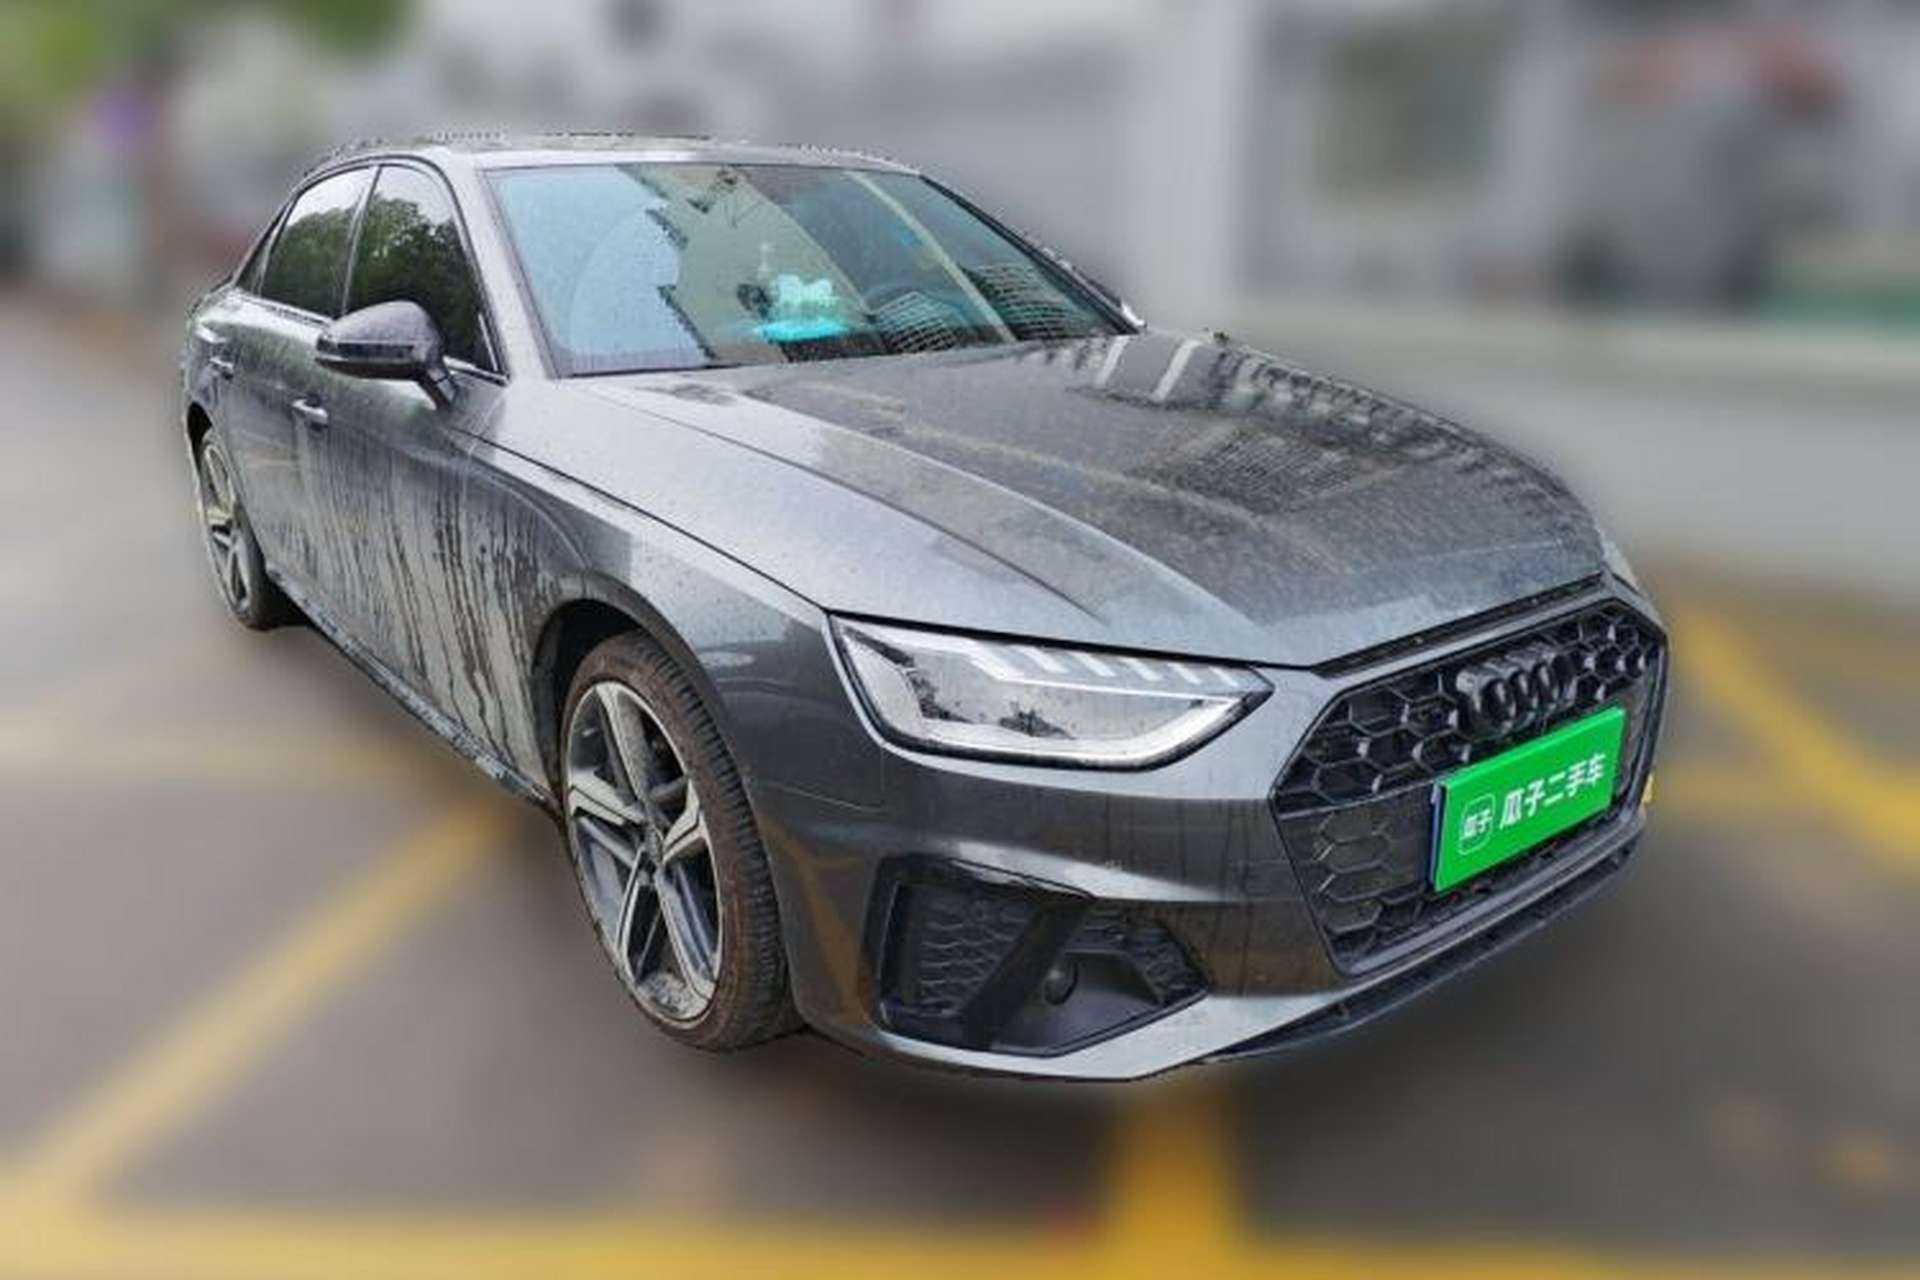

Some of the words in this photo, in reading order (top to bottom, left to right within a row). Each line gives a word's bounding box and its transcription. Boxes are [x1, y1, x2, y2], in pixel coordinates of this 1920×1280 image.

[1499, 752, 1606, 829] 瓜子二手车
